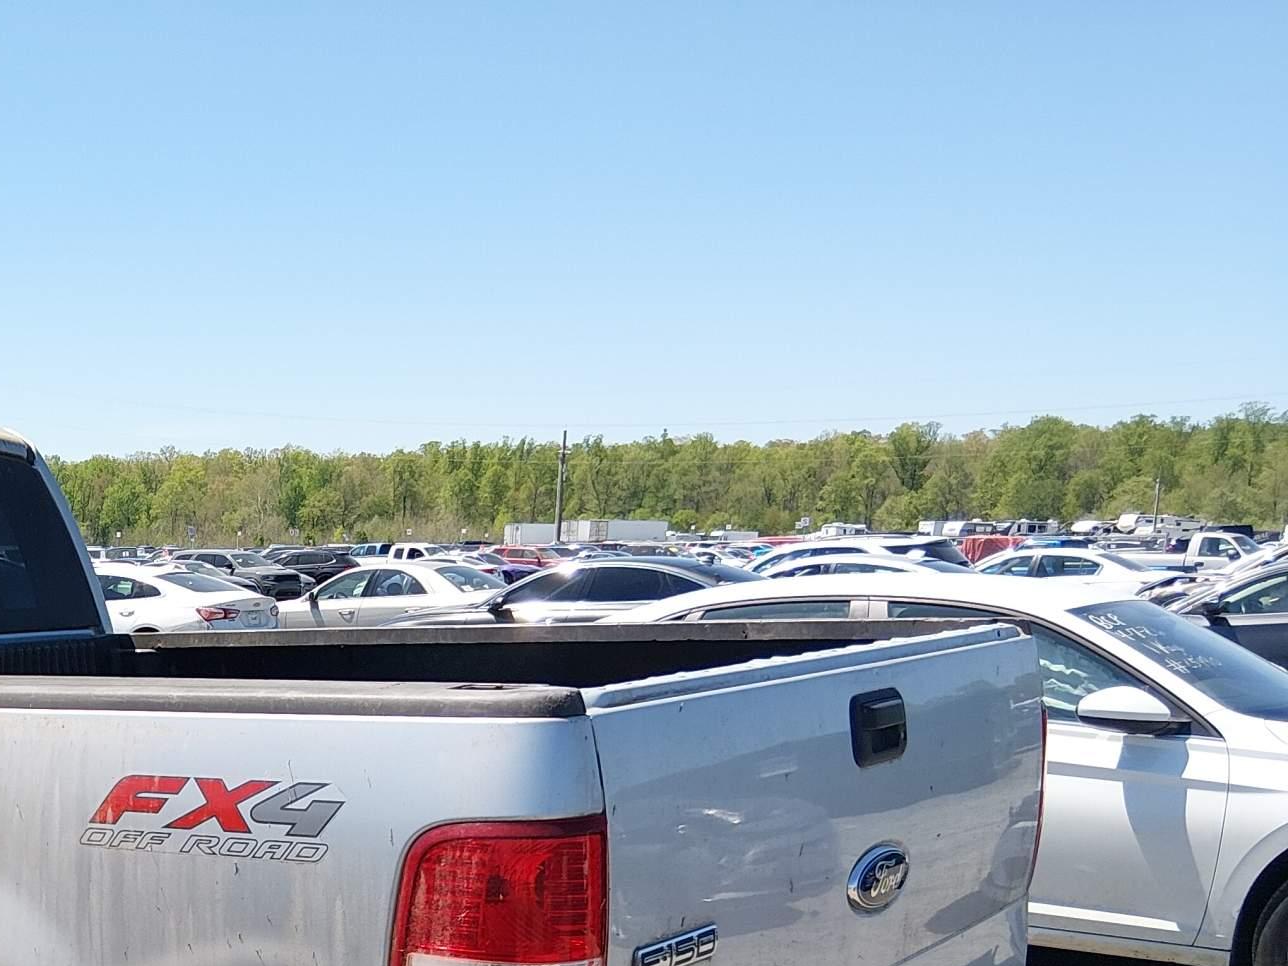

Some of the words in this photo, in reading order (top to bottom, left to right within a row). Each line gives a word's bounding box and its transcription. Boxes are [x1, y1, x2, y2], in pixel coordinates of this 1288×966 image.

[88, 774, 346, 838] FX4
[79, 827, 172, 851] OFF
[179, 834, 330, 863] ROAD
[869, 858, 906, 899] Ford
